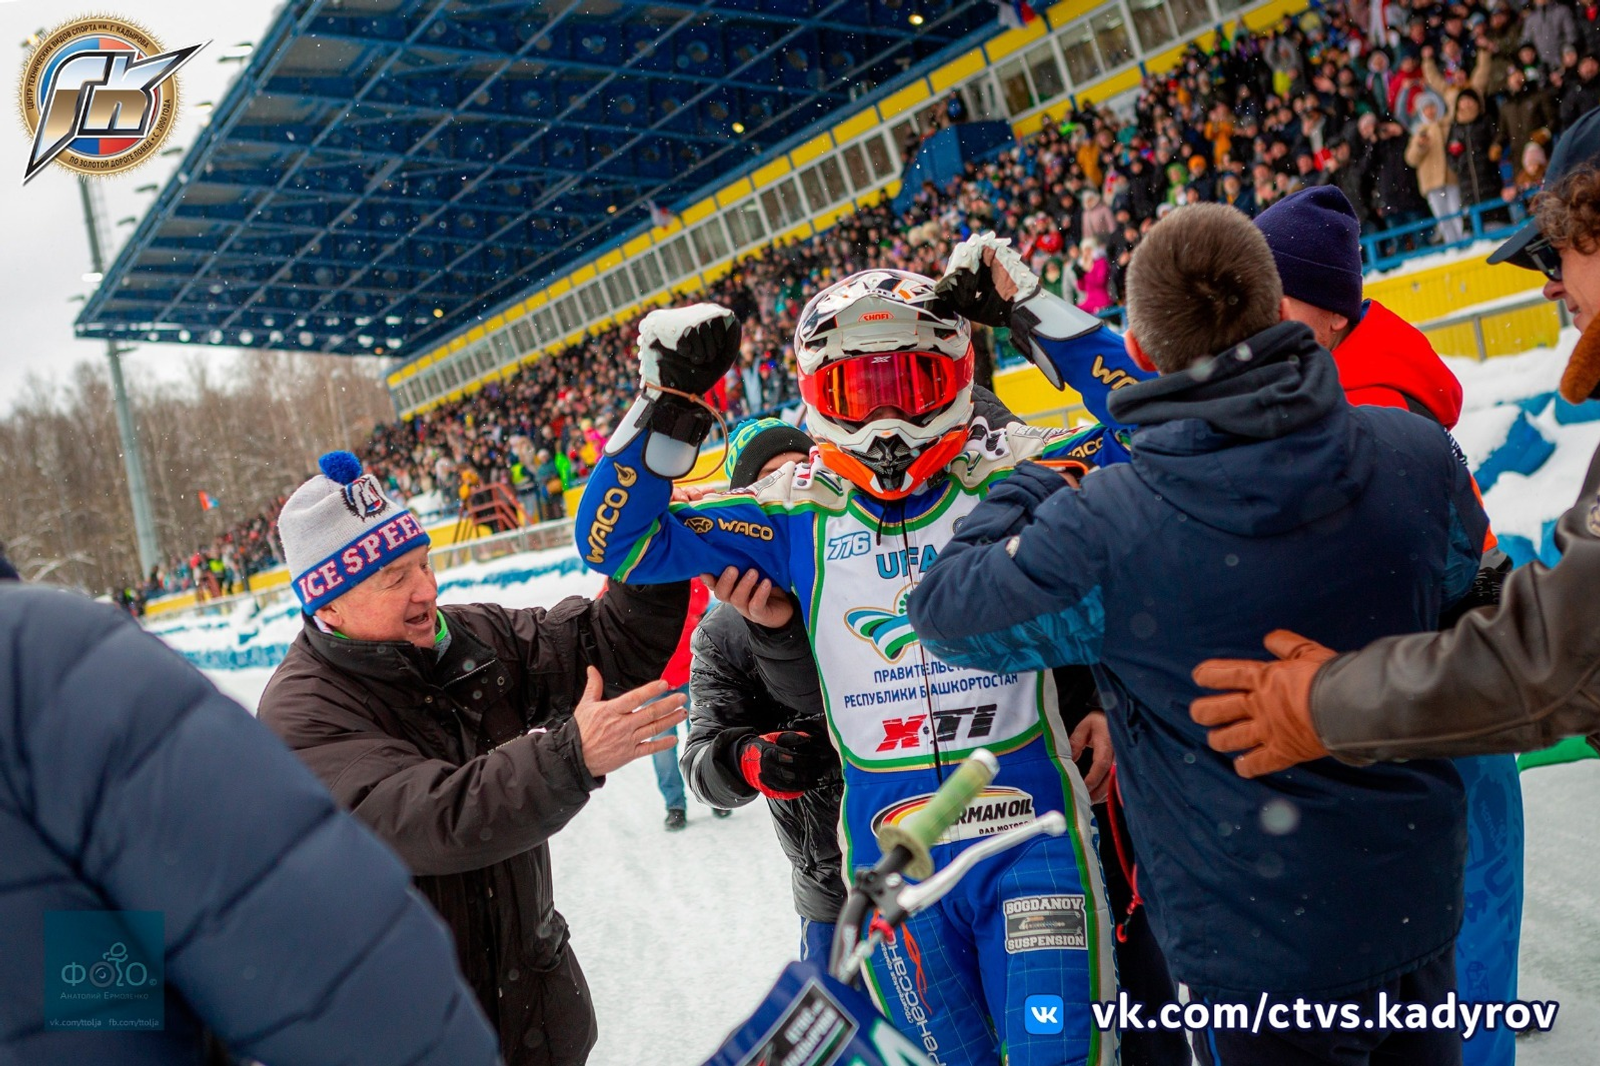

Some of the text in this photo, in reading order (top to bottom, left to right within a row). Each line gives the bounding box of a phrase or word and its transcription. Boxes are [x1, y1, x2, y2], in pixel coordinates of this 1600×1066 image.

[587, 487, 629, 564] WACO
[717, 518, 773, 541] WACO
[876, 545, 939, 579] UFA
[299, 561, 345, 603] ICE
[874, 661, 961, 683] ПРАВИТЕЛЬС
[844, 674, 1018, 708] РЕСПУБЛИКИ БАШКОРТОСТАН
[956, 799, 1032, 825] RMAN OIL
[979, 827, 995, 835] DAS
[1006, 898, 1081, 914] BOGDANOV
[1008, 935, 1084, 950] SUSPENSION
